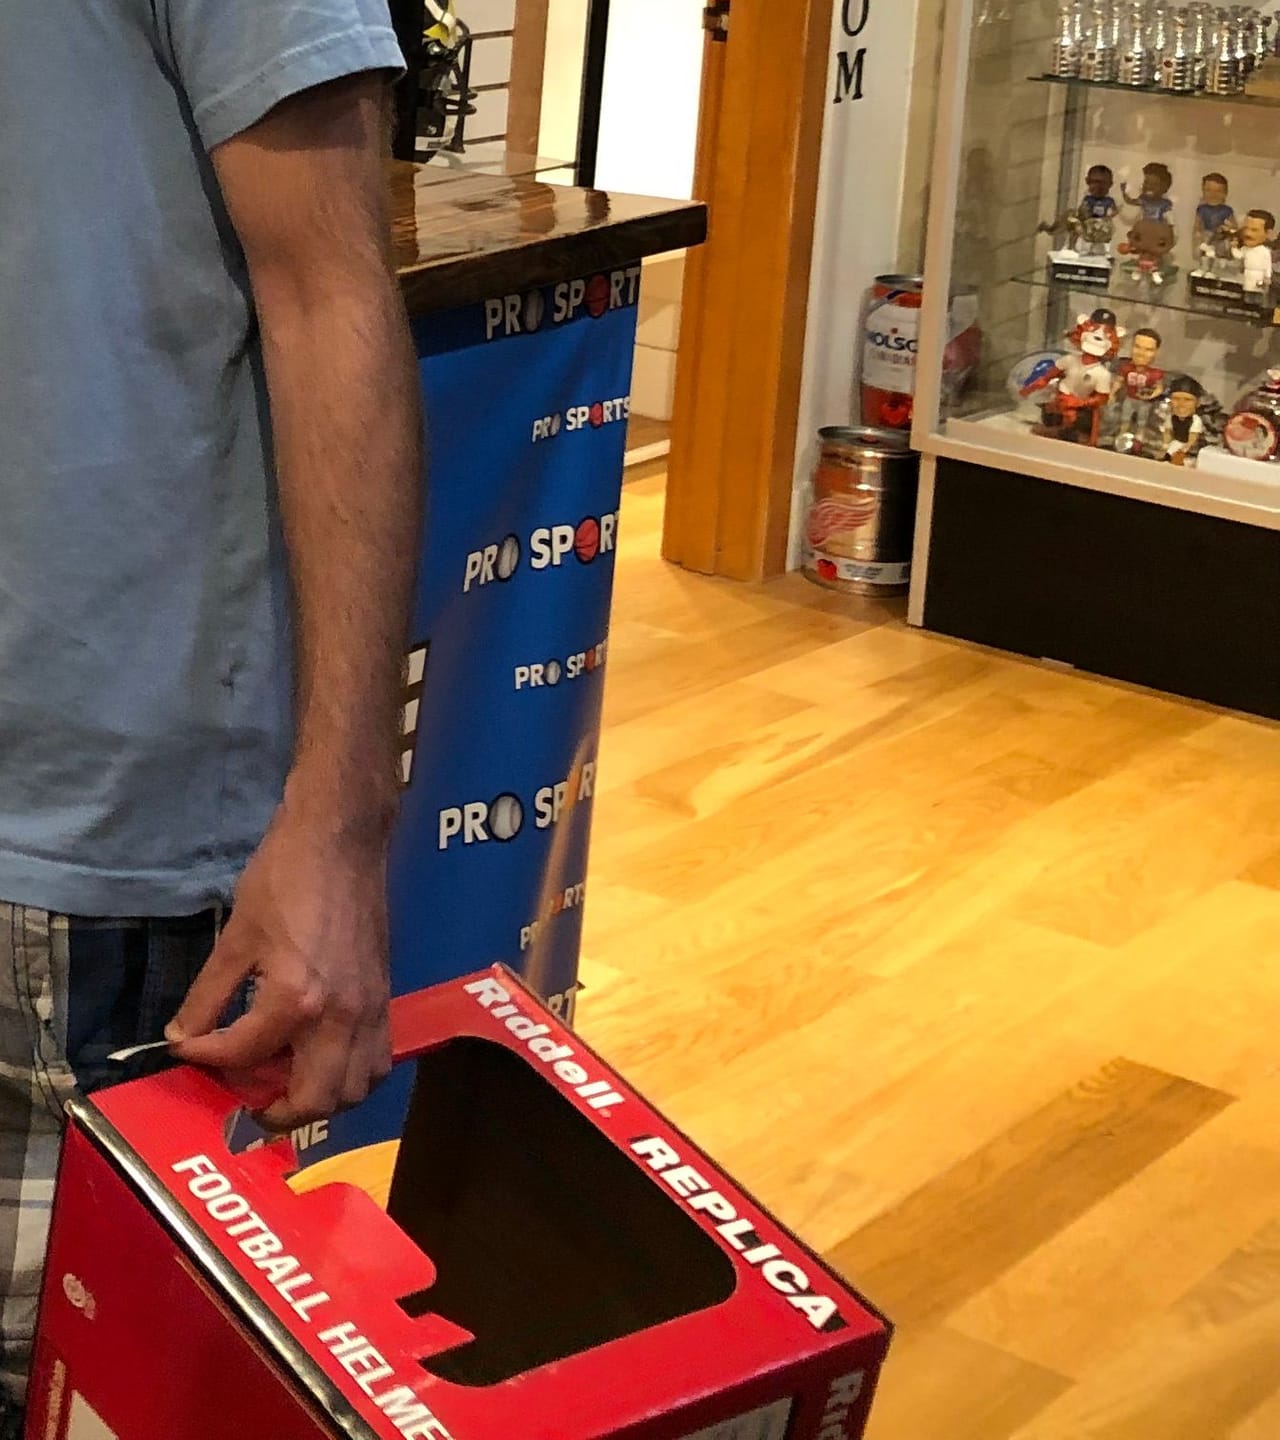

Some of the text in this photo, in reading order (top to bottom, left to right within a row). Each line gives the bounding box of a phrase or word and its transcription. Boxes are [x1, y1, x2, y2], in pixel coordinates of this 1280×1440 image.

[484, 289, 545, 340] PRO
[531, 412, 562, 443] PRO
[462, 532, 520, 594] PRO
[514, 658, 562, 691] PRO
[437, 792, 524, 851] PRO
[628, 1133, 842, 1333] REPLICA
[171, 1153, 452, 1440] FOOTBALL HELME
